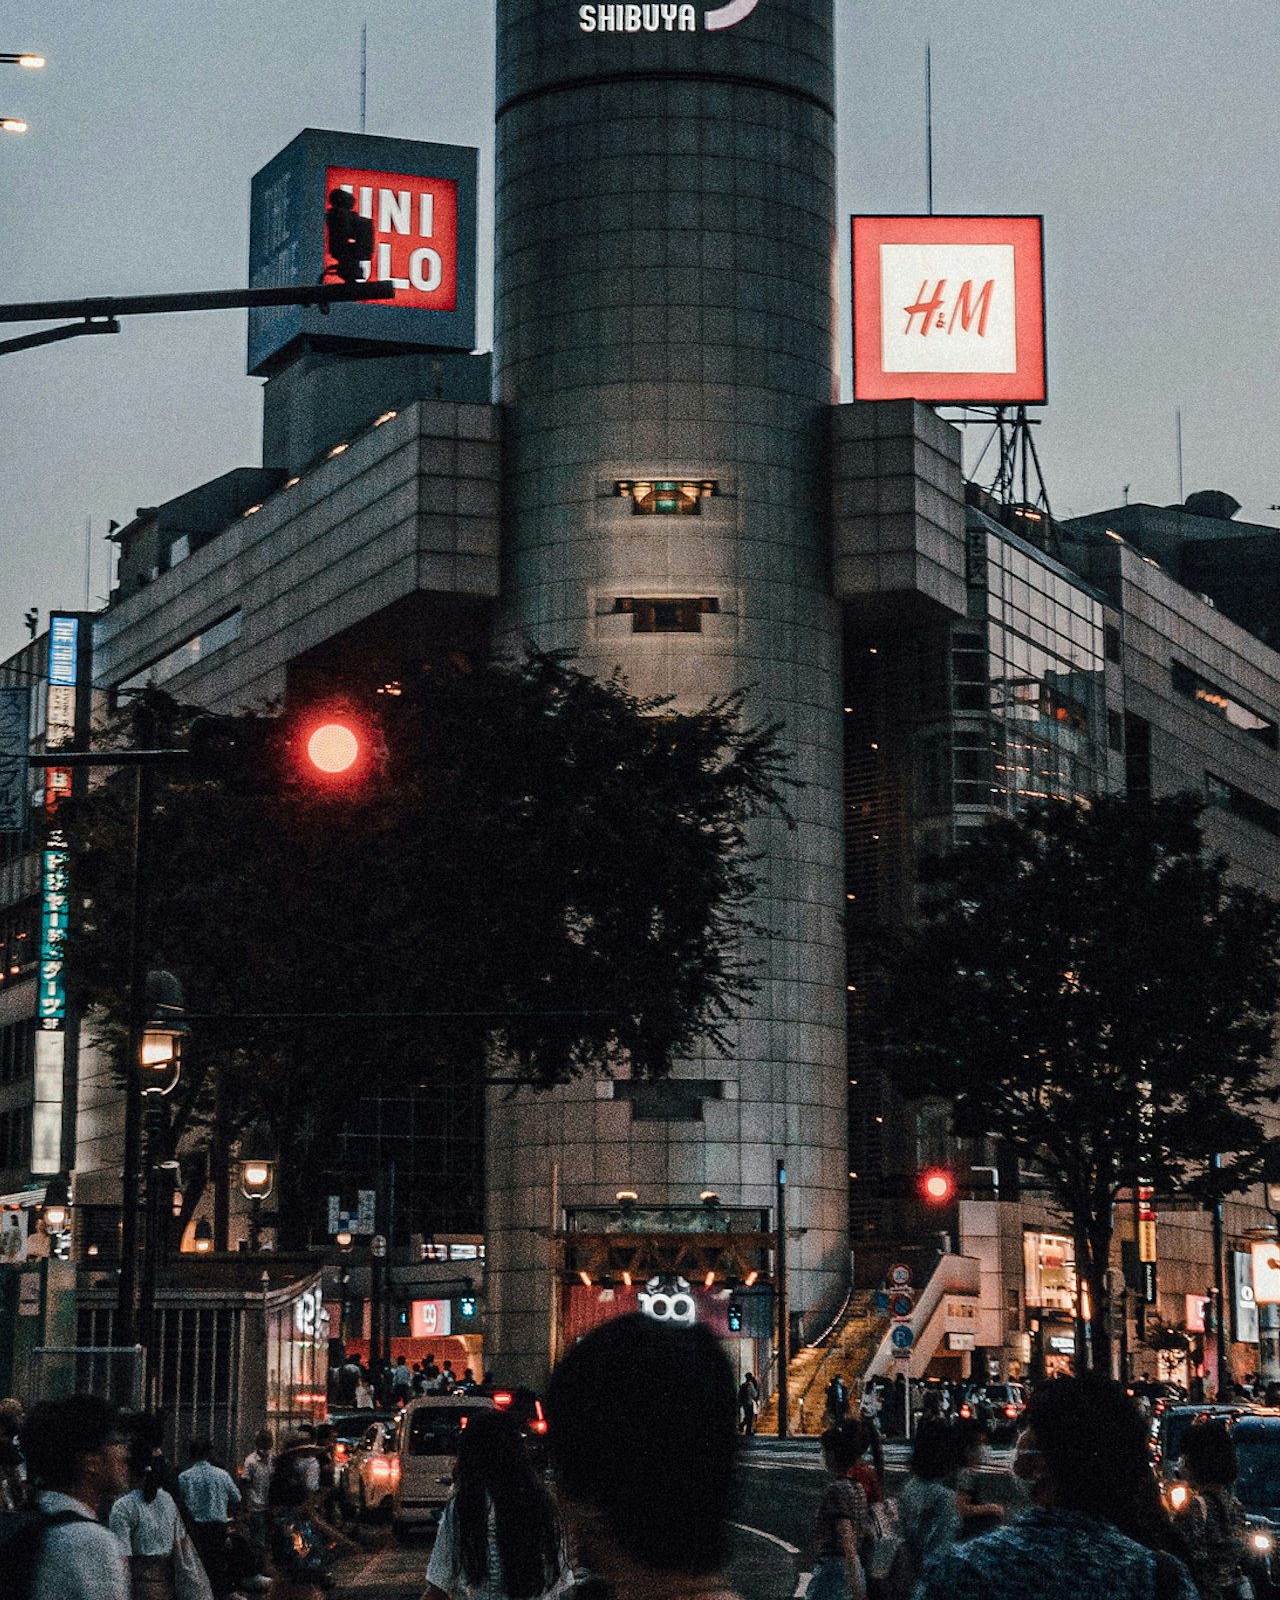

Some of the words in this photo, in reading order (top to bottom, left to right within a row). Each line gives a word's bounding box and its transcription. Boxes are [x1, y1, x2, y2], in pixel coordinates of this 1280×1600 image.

[579, 3, 697, 33] SHIBUYA
[354, 243, 443, 293] LO
[904, 278, 996, 339] H&M
